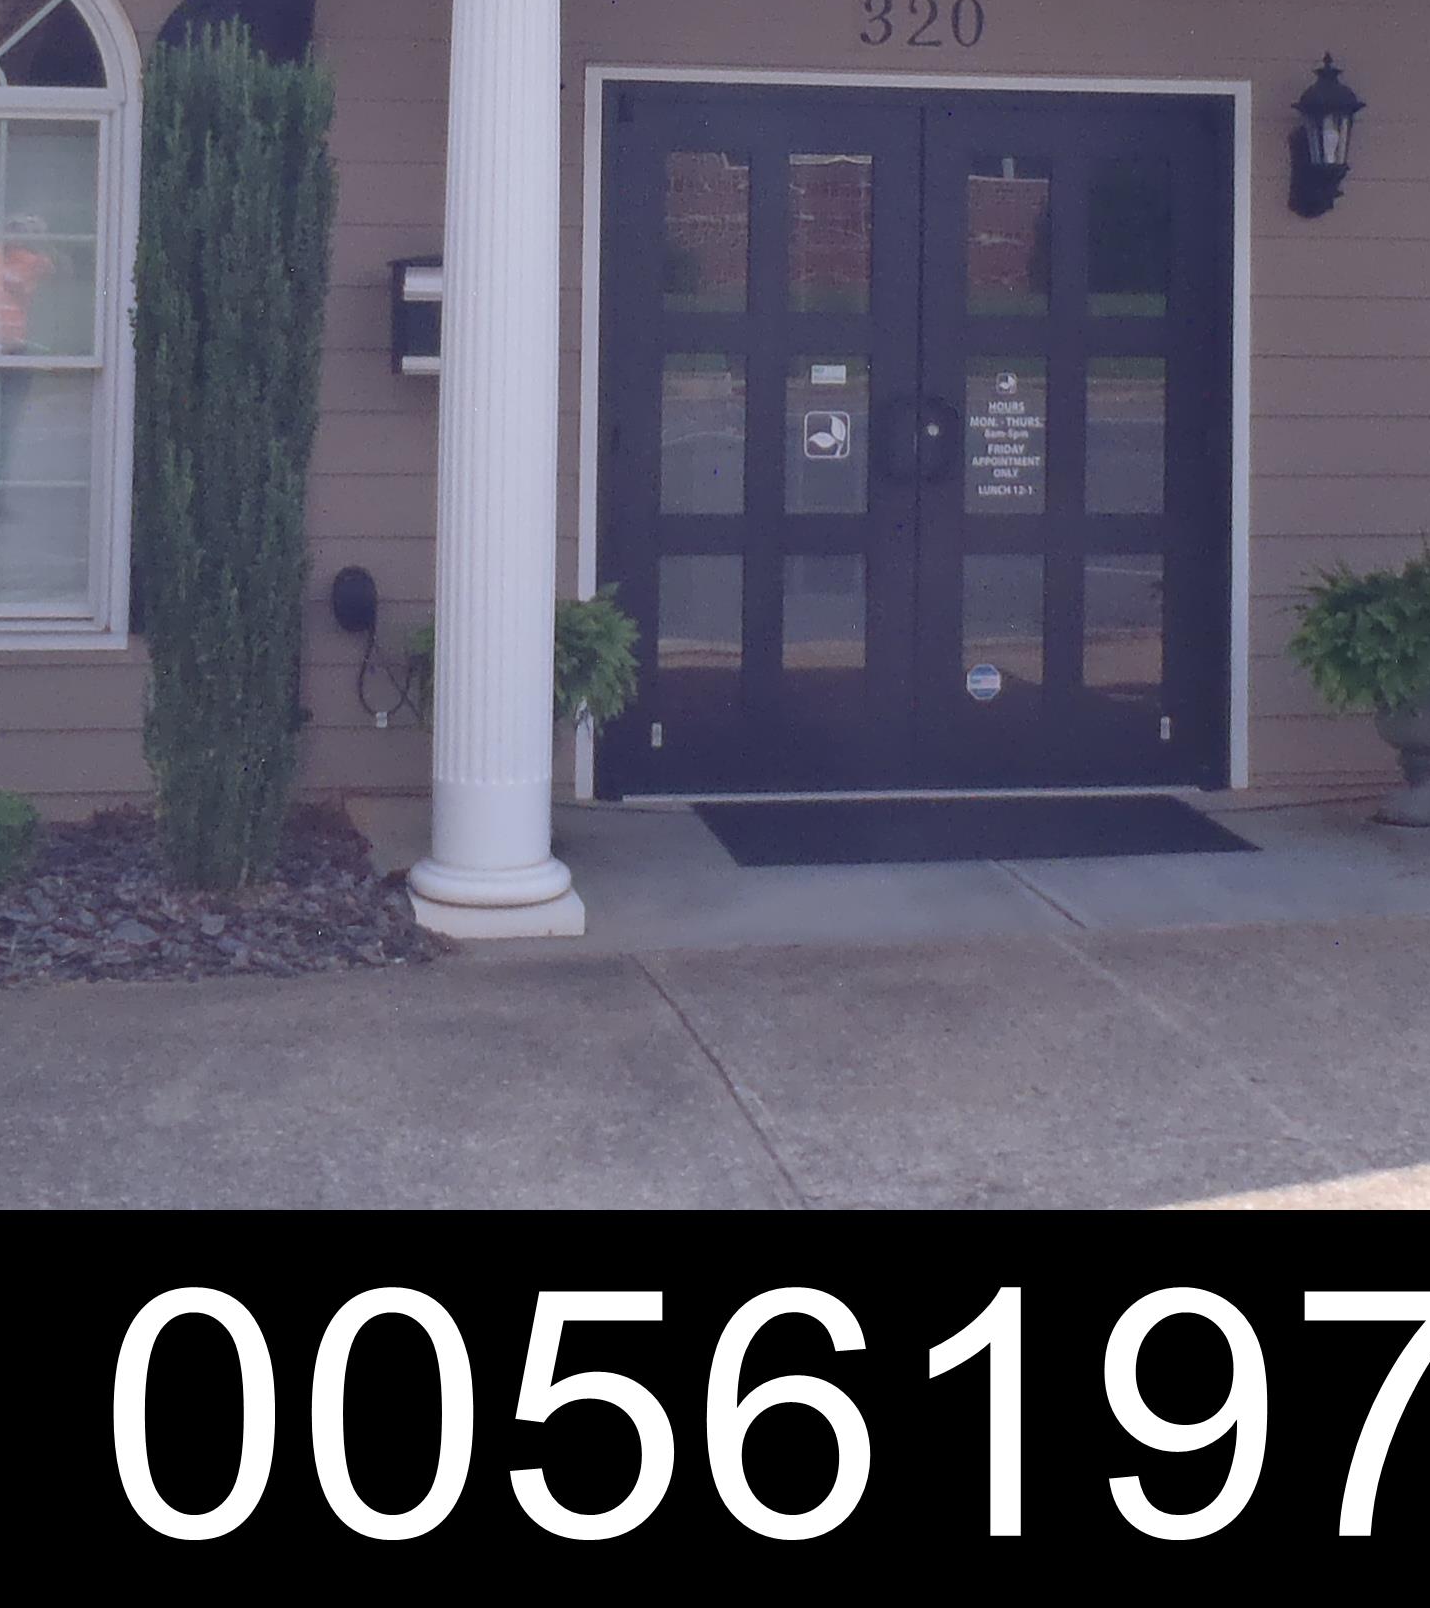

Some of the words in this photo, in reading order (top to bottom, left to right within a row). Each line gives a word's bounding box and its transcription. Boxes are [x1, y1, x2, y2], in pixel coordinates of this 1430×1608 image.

[988, 401, 1025, 413] HOURS
[970, 416, 998, 427] MON.
[987, 443, 1025, 455] FRIDAY
[972, 456, 1041, 466] APPOINTMENT
[993, 467, 1019, 478] ONLY
[978, 485, 1011, 495] LUNCH
